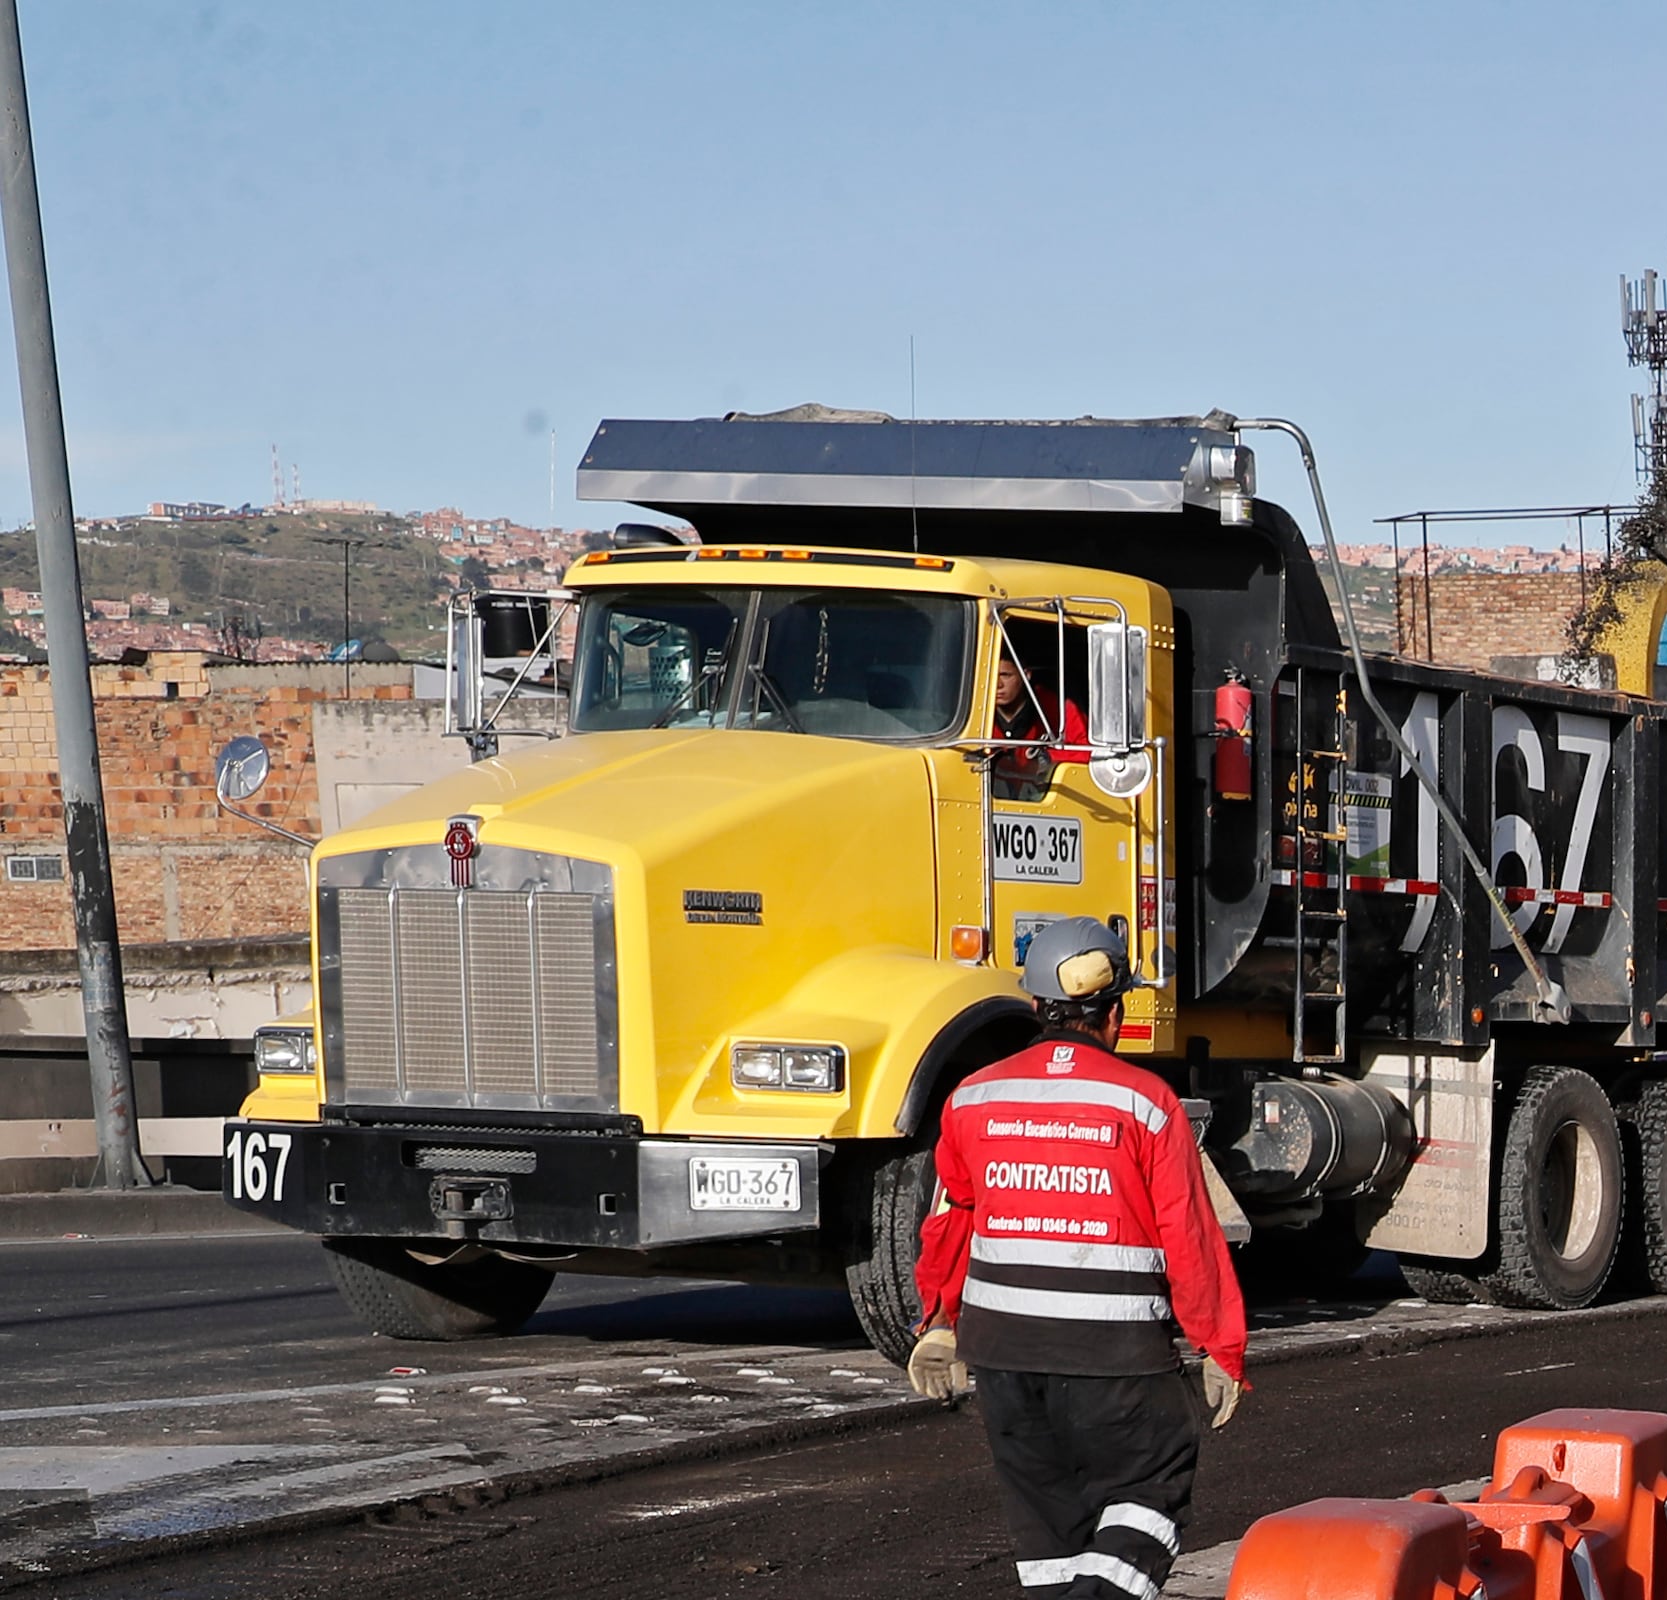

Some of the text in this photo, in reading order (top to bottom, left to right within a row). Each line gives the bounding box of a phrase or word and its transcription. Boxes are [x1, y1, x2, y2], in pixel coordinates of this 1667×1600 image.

[1399, 691, 1611, 955] 167
[993, 823, 1078, 863] WGO 367
[1016, 865, 1060, 876] LA CALERA
[684, 891, 761, 909] KENWORTH
[986, 1119, 1024, 1137] Consorcio
[1068, 1122, 1099, 1141] Carrera
[1100, 1125, 1112, 1143] 68
[227, 1131, 291, 1201] 167
[985, 1161, 1112, 1195] CONTRATISTA
[695, 1169, 793, 1195] WGO 367
[737, 1197, 772, 1205] CALERA
[987, 1215, 1108, 1236] Contrato IDU 0345 de 2020
